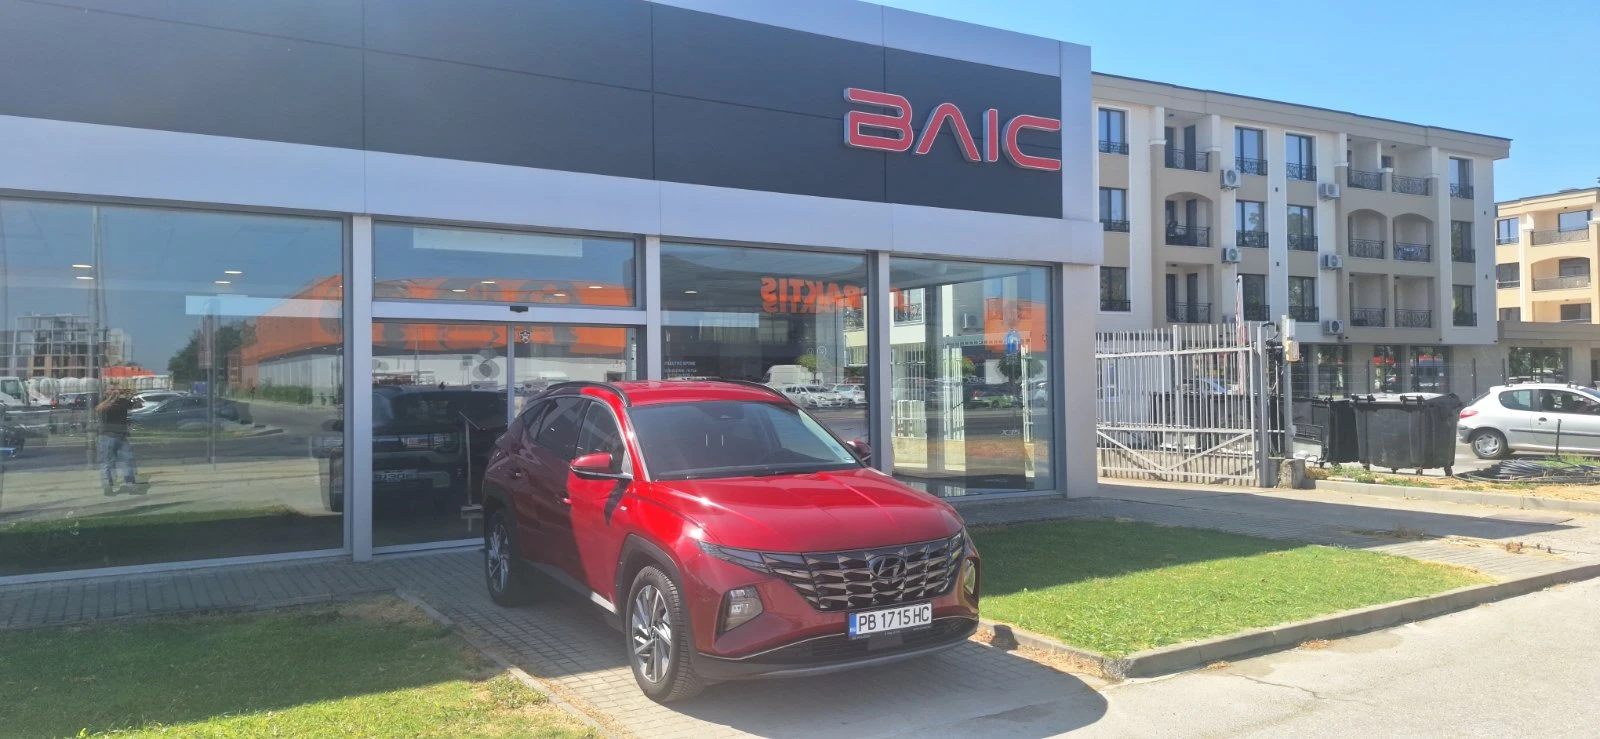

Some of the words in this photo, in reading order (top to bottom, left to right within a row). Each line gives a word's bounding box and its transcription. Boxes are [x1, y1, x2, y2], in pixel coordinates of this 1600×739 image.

[843, 87, 1062, 171] BAIC
[859, 615, 876, 632] PB
[881, 610, 911, 629] 1715
[913, 607, 929, 624] HC
